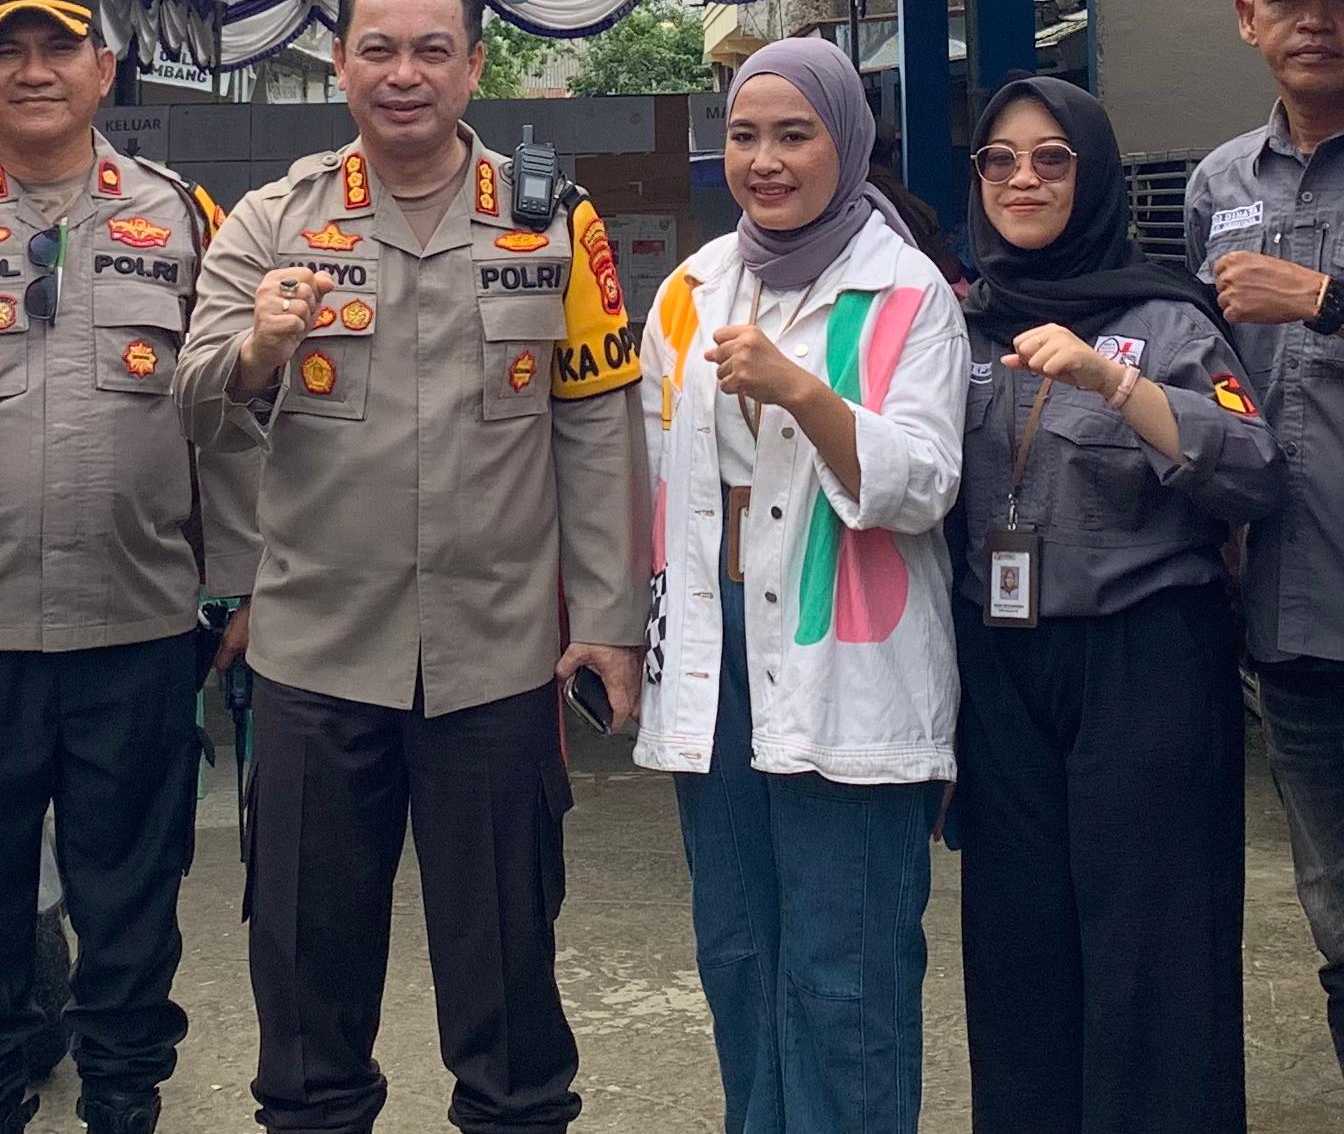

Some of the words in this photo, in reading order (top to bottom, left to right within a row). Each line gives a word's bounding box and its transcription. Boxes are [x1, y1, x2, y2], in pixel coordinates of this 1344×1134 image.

[105, 118, 162, 133] KELUAR
[94, 254, 179, 284] POLRI
[480, 264, 562, 291] POLRI
[556, 342, 599, 383] KA
